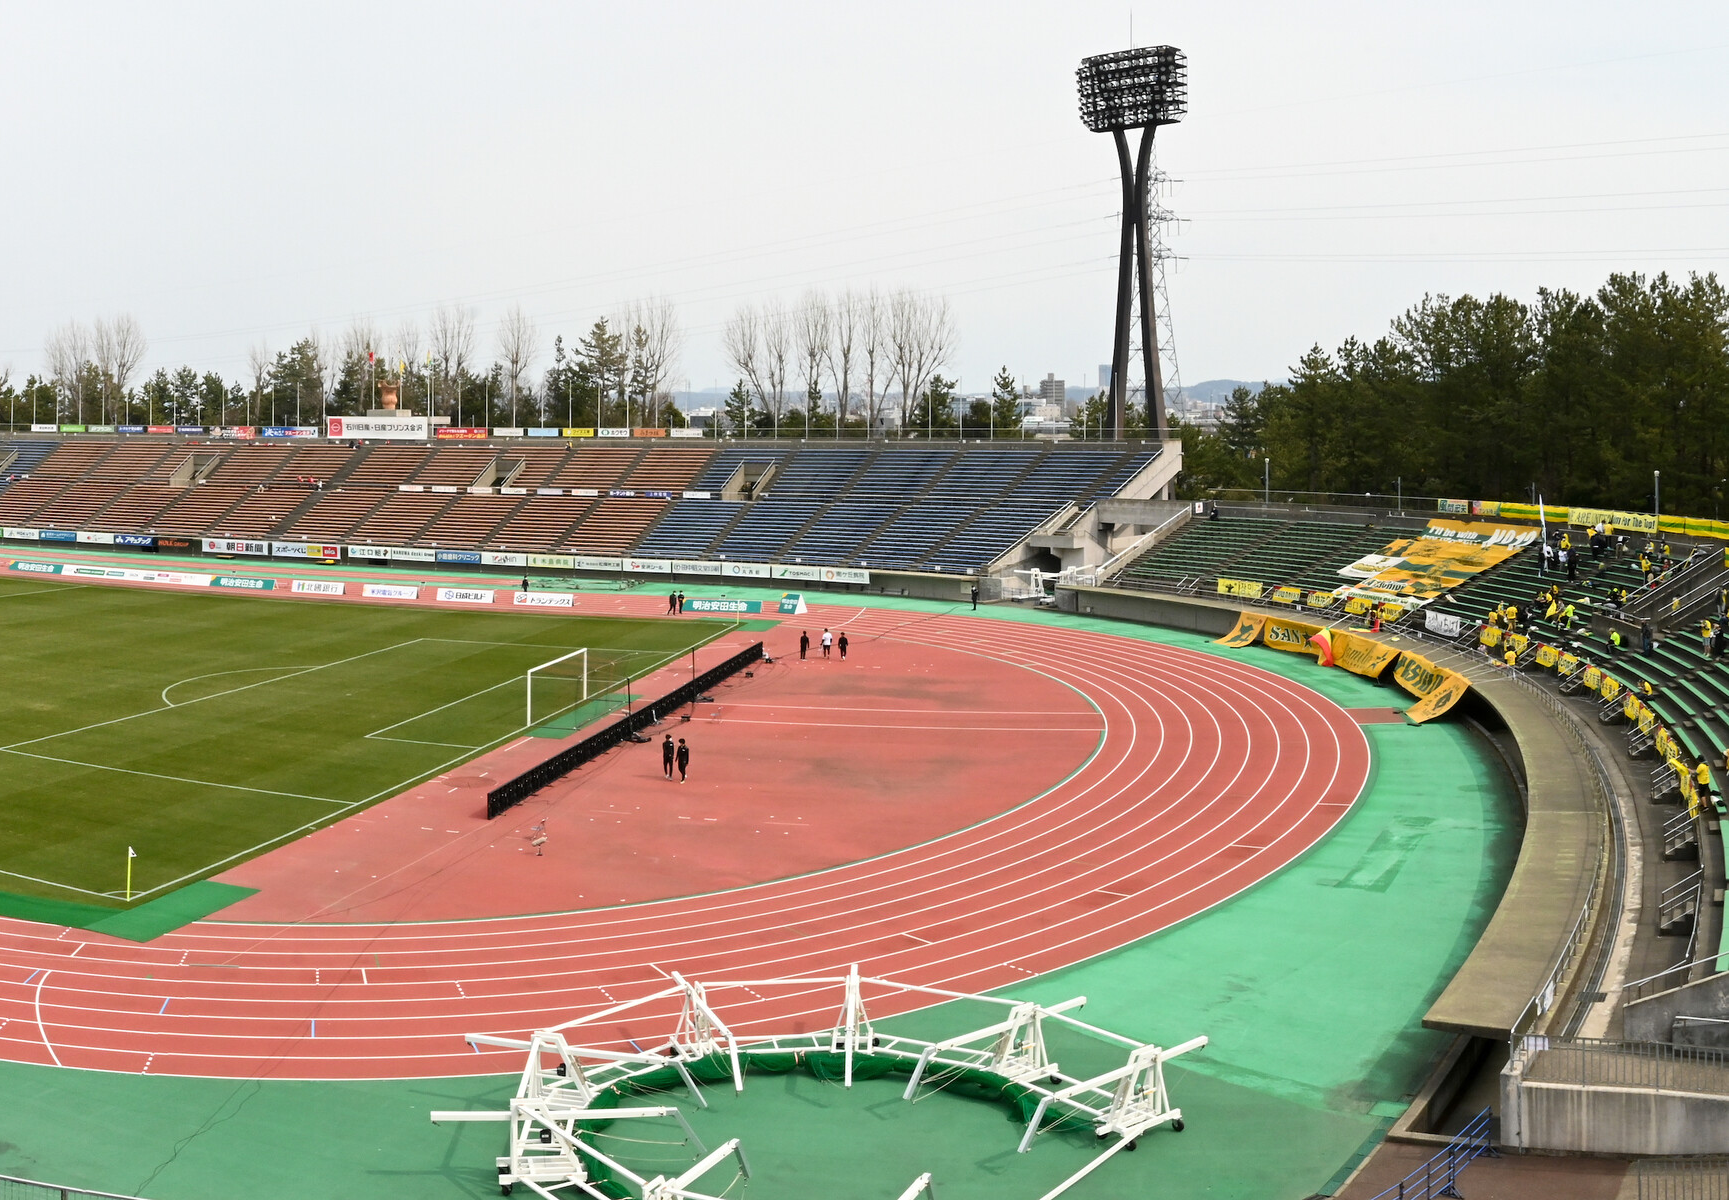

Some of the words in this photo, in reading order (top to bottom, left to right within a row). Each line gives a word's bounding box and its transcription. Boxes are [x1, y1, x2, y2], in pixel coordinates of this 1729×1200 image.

[1457, 531, 1479, 540] with
[226, 542, 264, 553] 朝日新聞
[275, 546, 307, 554] スポーツくじ
[17, 562, 55, 573] 明治安田生命
[219, 577, 264, 589] 明治安田生命
[530, 597, 570, 606] トランテックス
[692, 600, 748, 612] 明治安田生命
